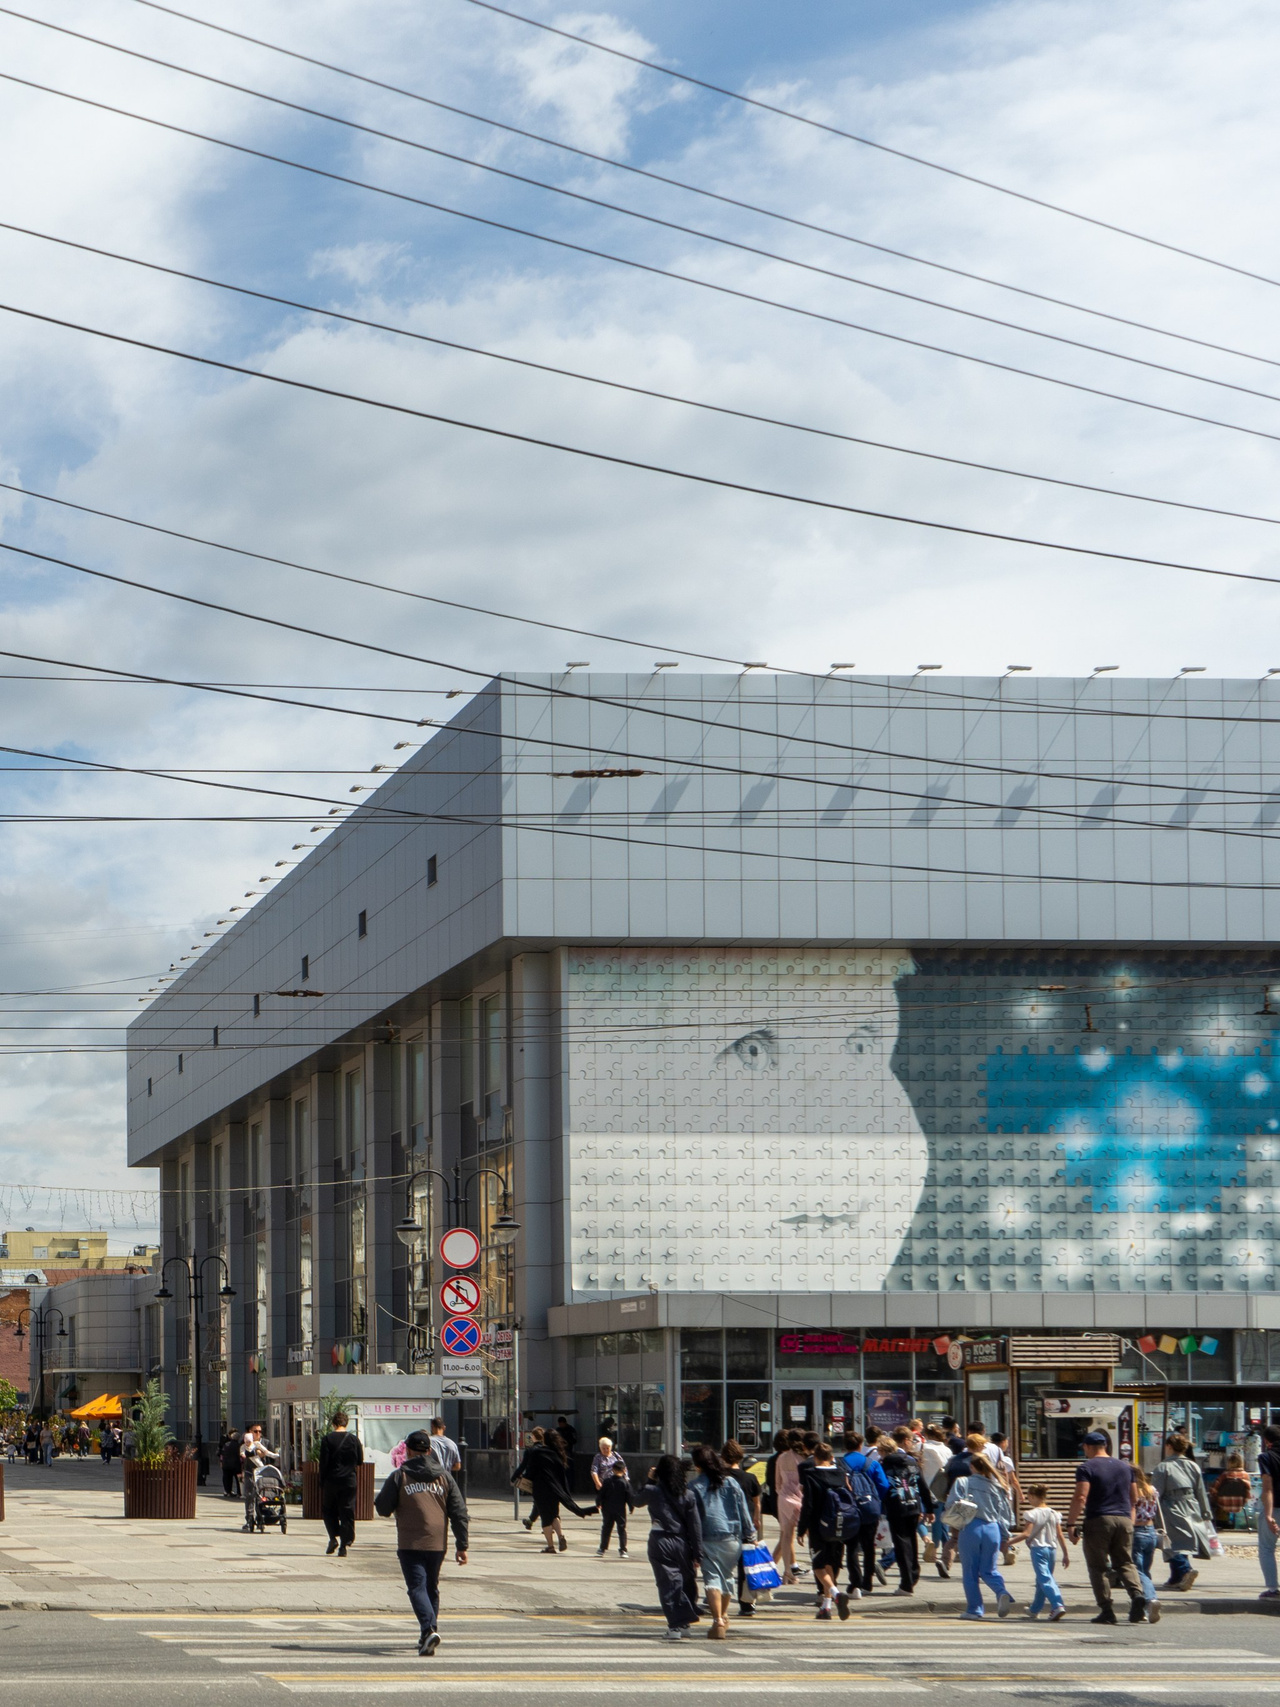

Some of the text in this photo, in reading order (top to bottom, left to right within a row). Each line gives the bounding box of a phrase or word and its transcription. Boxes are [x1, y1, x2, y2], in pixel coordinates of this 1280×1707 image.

[973, 1343, 997, 1356] КОФЕ
[442, 1363, 481, 1371] 11.00-6.00
[374, 1404, 422, 1414] ЦВЕТЫ
